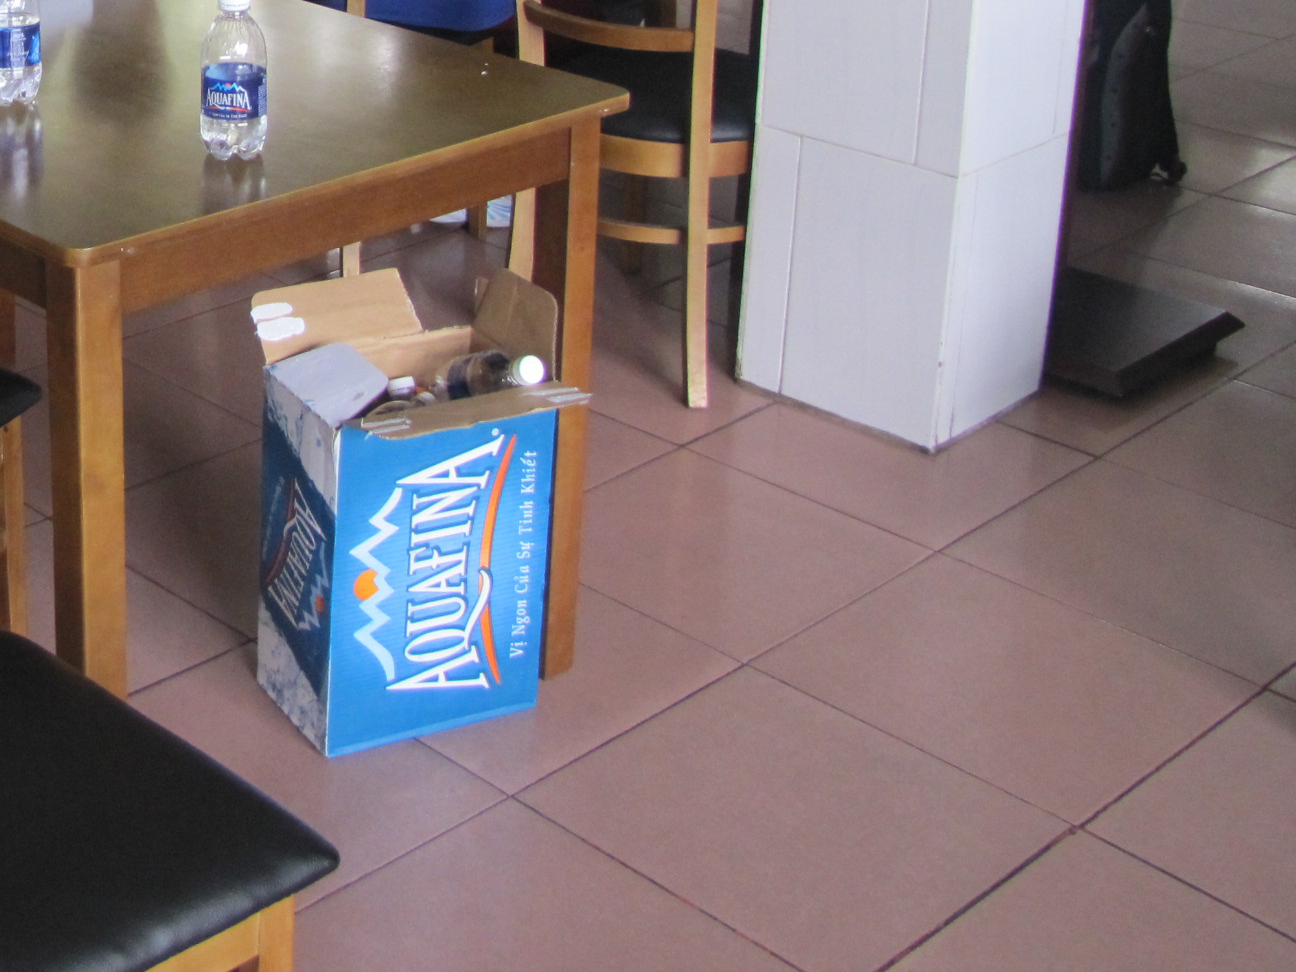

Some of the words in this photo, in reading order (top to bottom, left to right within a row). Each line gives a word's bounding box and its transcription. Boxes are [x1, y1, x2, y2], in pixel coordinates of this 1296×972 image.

[206, 86, 252, 111] AQUAFINA
[519, 449, 538, 494] Khiết
[518, 500, 534, 535] Tinh
[267, 477, 327, 630] AQUAFINA
[386, 433, 505, 691] AQUAFINA
[513, 565, 530, 594] Của
[510, 599, 531, 636] Ngon
[509, 640, 527, 659] Vị
